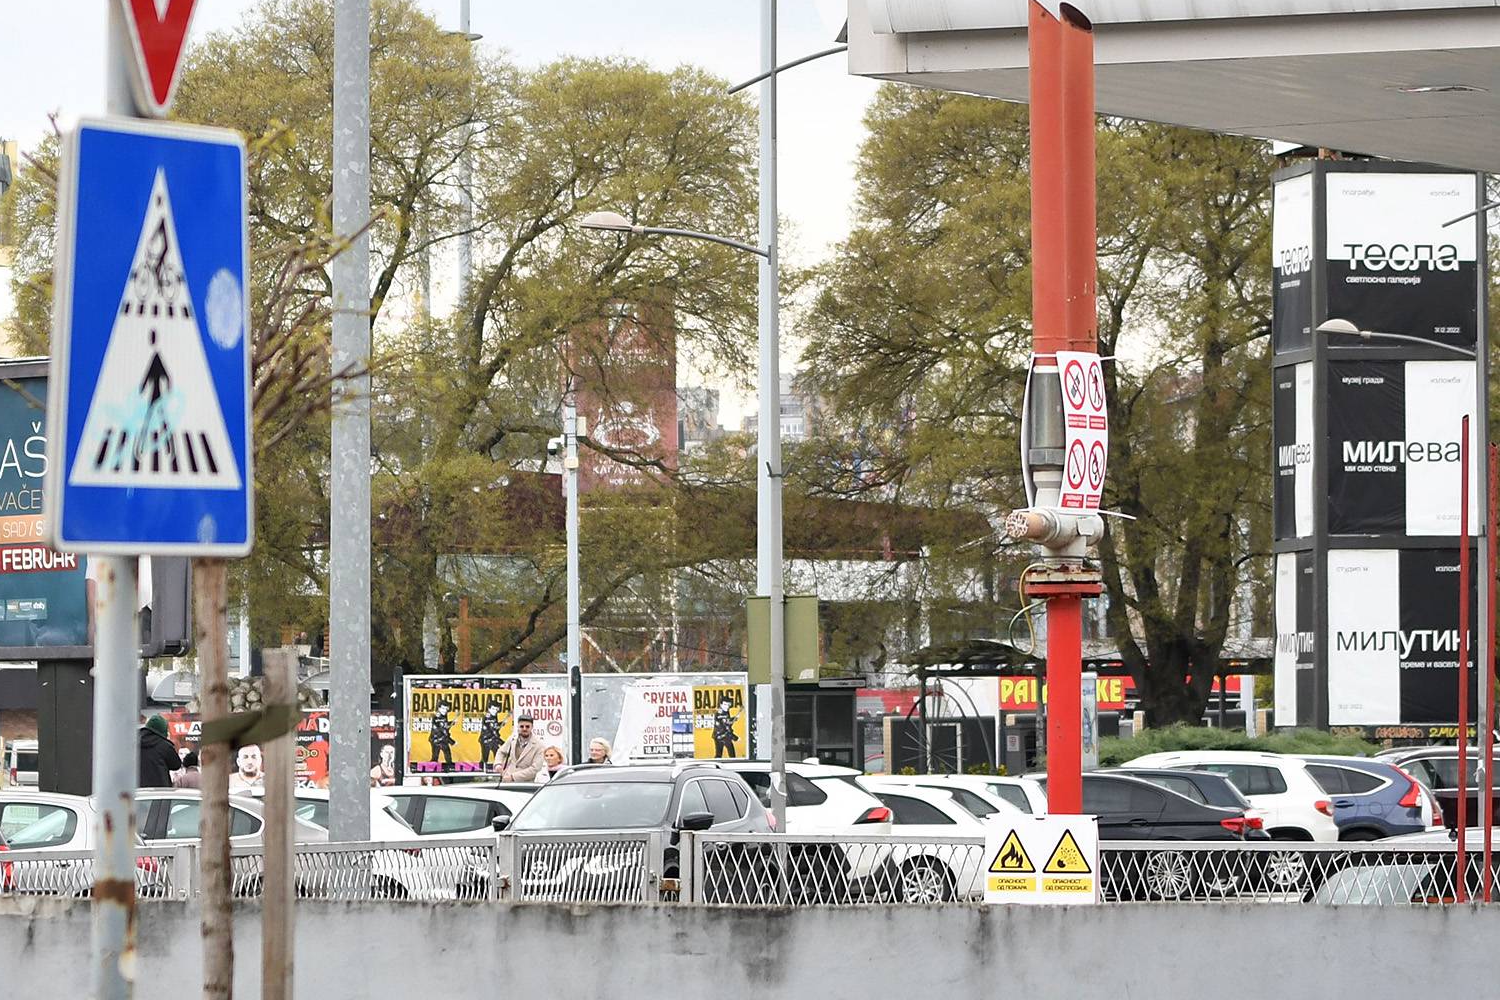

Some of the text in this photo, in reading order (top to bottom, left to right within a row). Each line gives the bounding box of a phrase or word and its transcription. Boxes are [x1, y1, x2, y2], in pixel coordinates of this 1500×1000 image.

[1343, 243, 1460, 271] тесла
[1343, 441, 1461, 464] милева
[2, 520, 28, 539] SAD
[2, 547, 77, 571] FEBRUAR
[1337, 630, 1470, 659] милутин
[518, 694, 563, 707] CRVENA
[643, 734, 670, 745] SPENS
